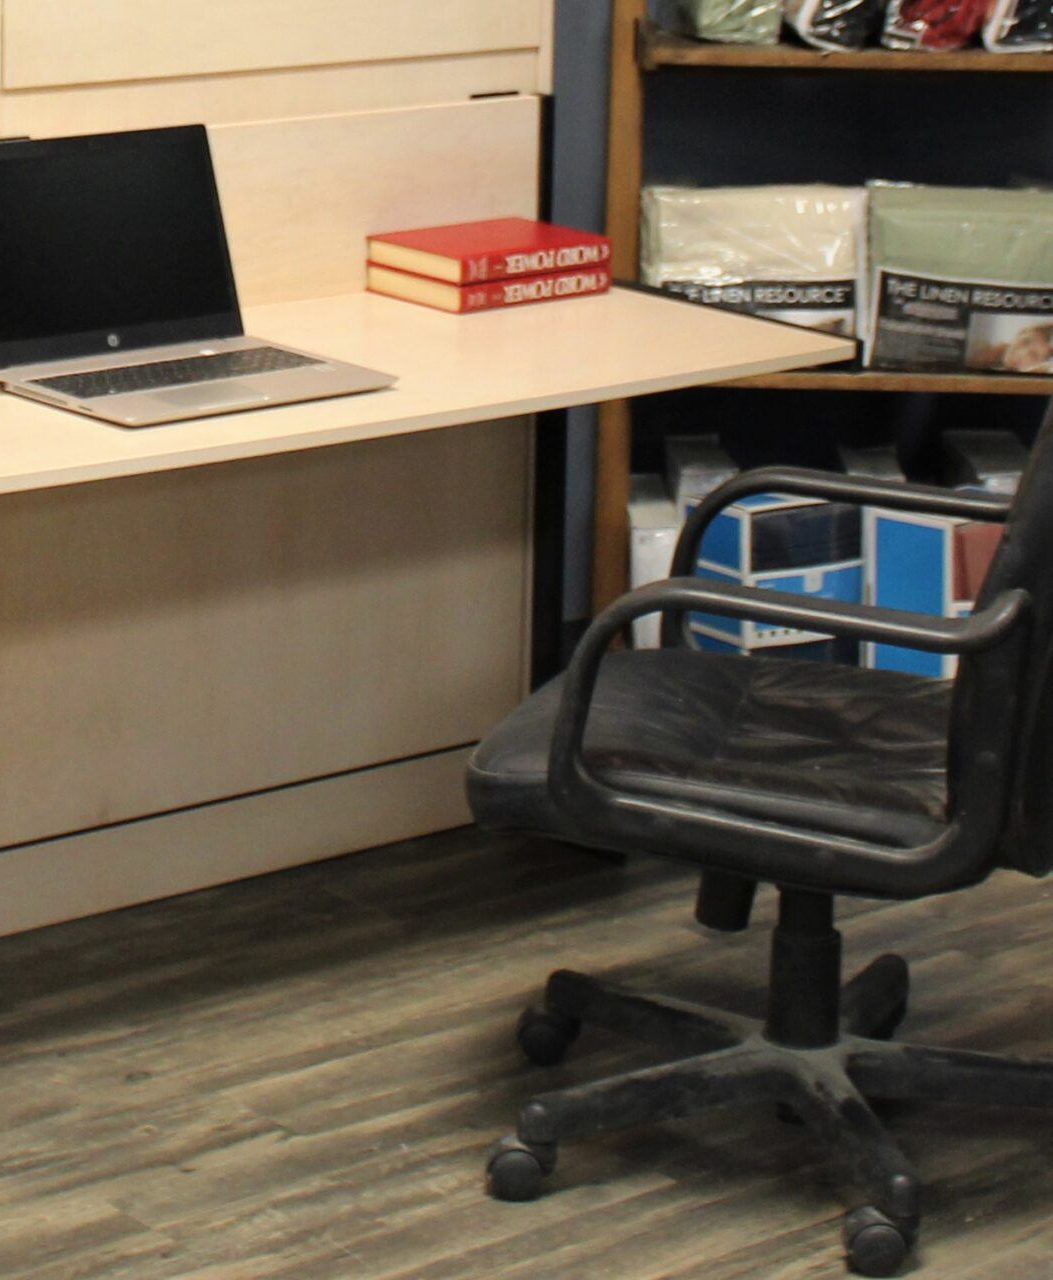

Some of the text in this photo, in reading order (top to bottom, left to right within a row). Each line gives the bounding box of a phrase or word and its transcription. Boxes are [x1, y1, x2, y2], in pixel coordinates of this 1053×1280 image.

[505, 250, 555, 273] POWER
[504, 279, 554, 303] POWER
[887, 278, 918, 299] THE
[920, 285, 970, 304] LINEN
